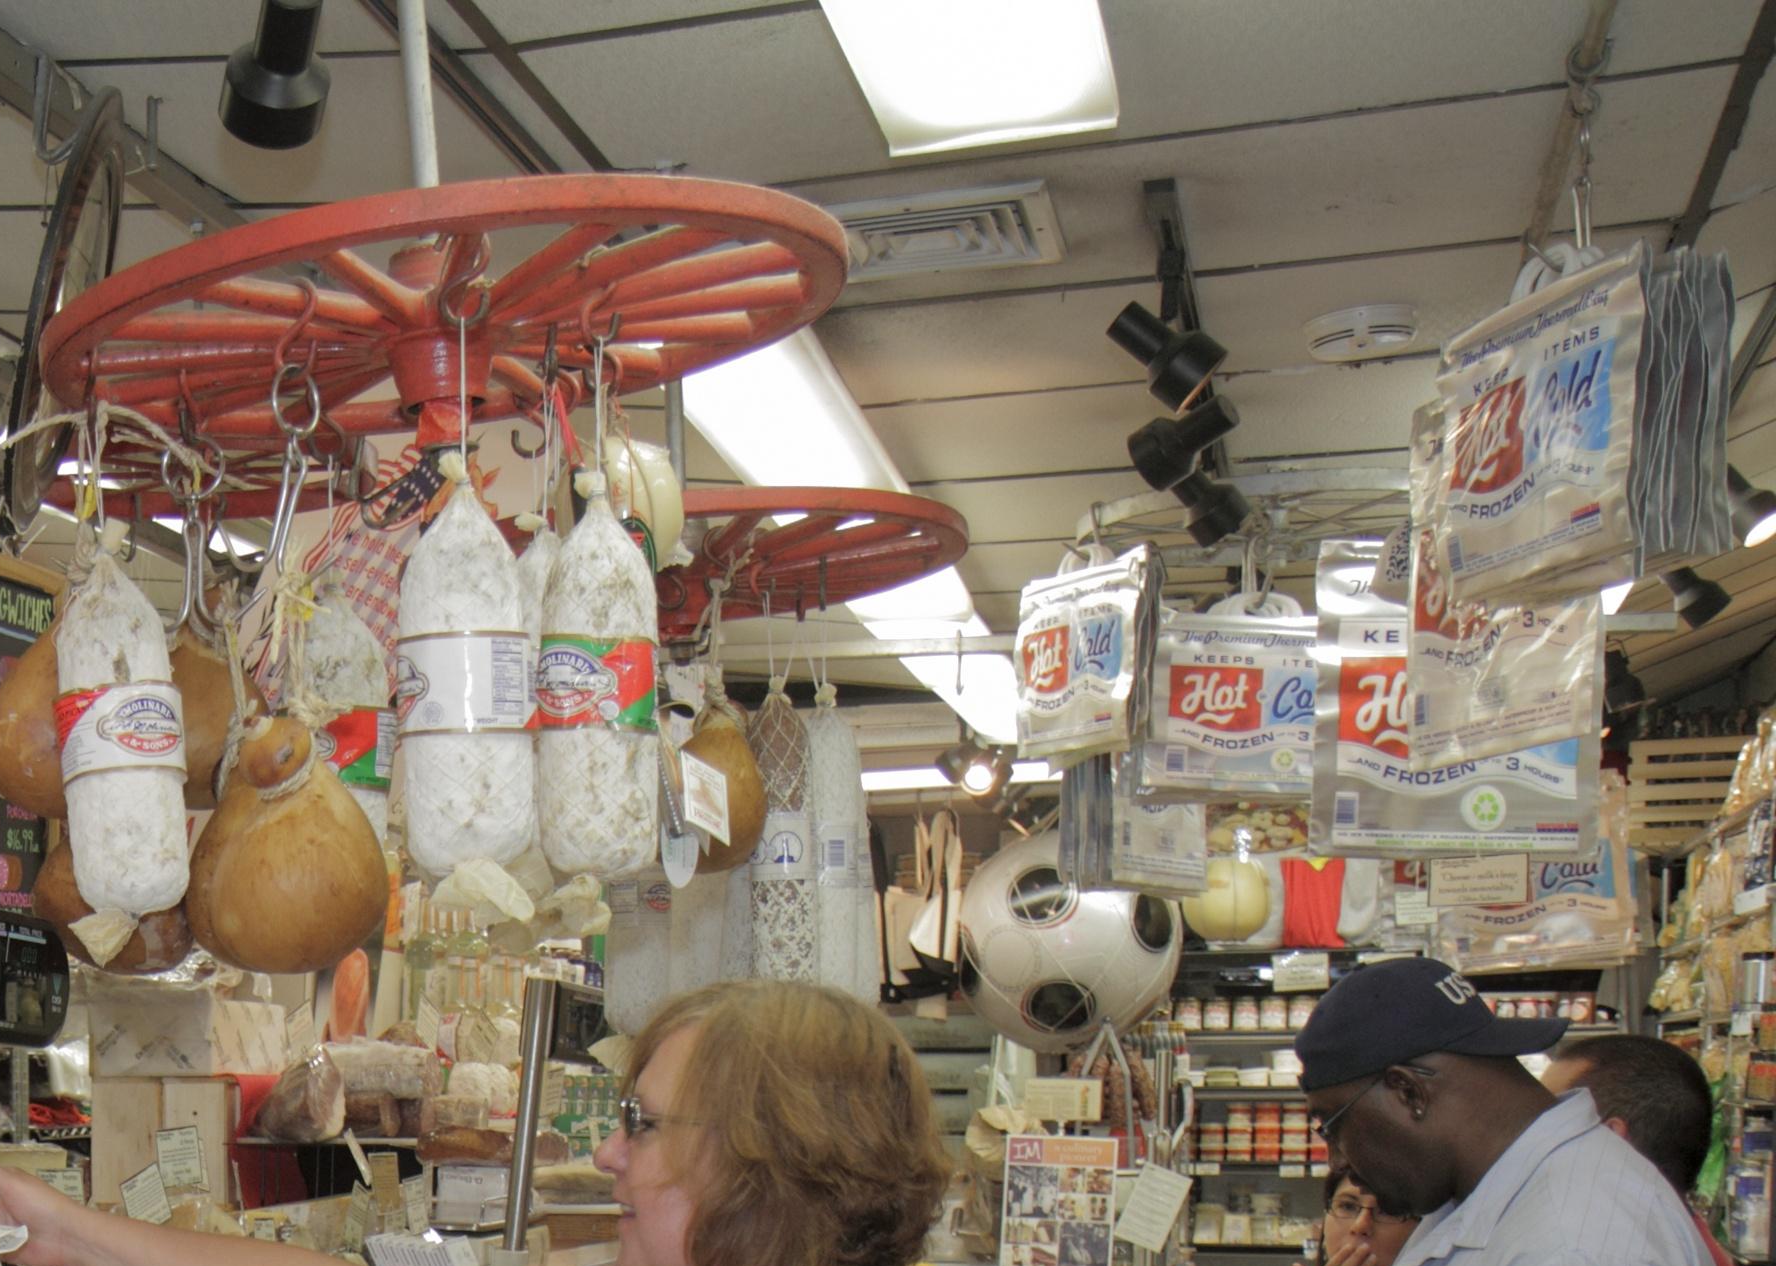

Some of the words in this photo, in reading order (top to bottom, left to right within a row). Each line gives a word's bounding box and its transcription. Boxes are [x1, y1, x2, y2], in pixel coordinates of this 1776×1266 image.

[1543, 326, 1601, 360] ITEMS
[1469, 474, 1536, 520] FROZEN
[1027, 635, 1062, 677] Hot
[1194, 655, 1255, 665] KEEPS
[1181, 672, 1248, 715] Hot
[124, 699, 173, 719] MOLINARI
[1202, 732, 1274, 750] FROZEN
[1297, 732, 1309, 742] 3
[1382, 761, 1477, 786] FROZEN
[1506, 757, 1520, 771] 3
[1483, 905, 1547, 925] FROZEN
[1567, 898, 1577, 908] 3
